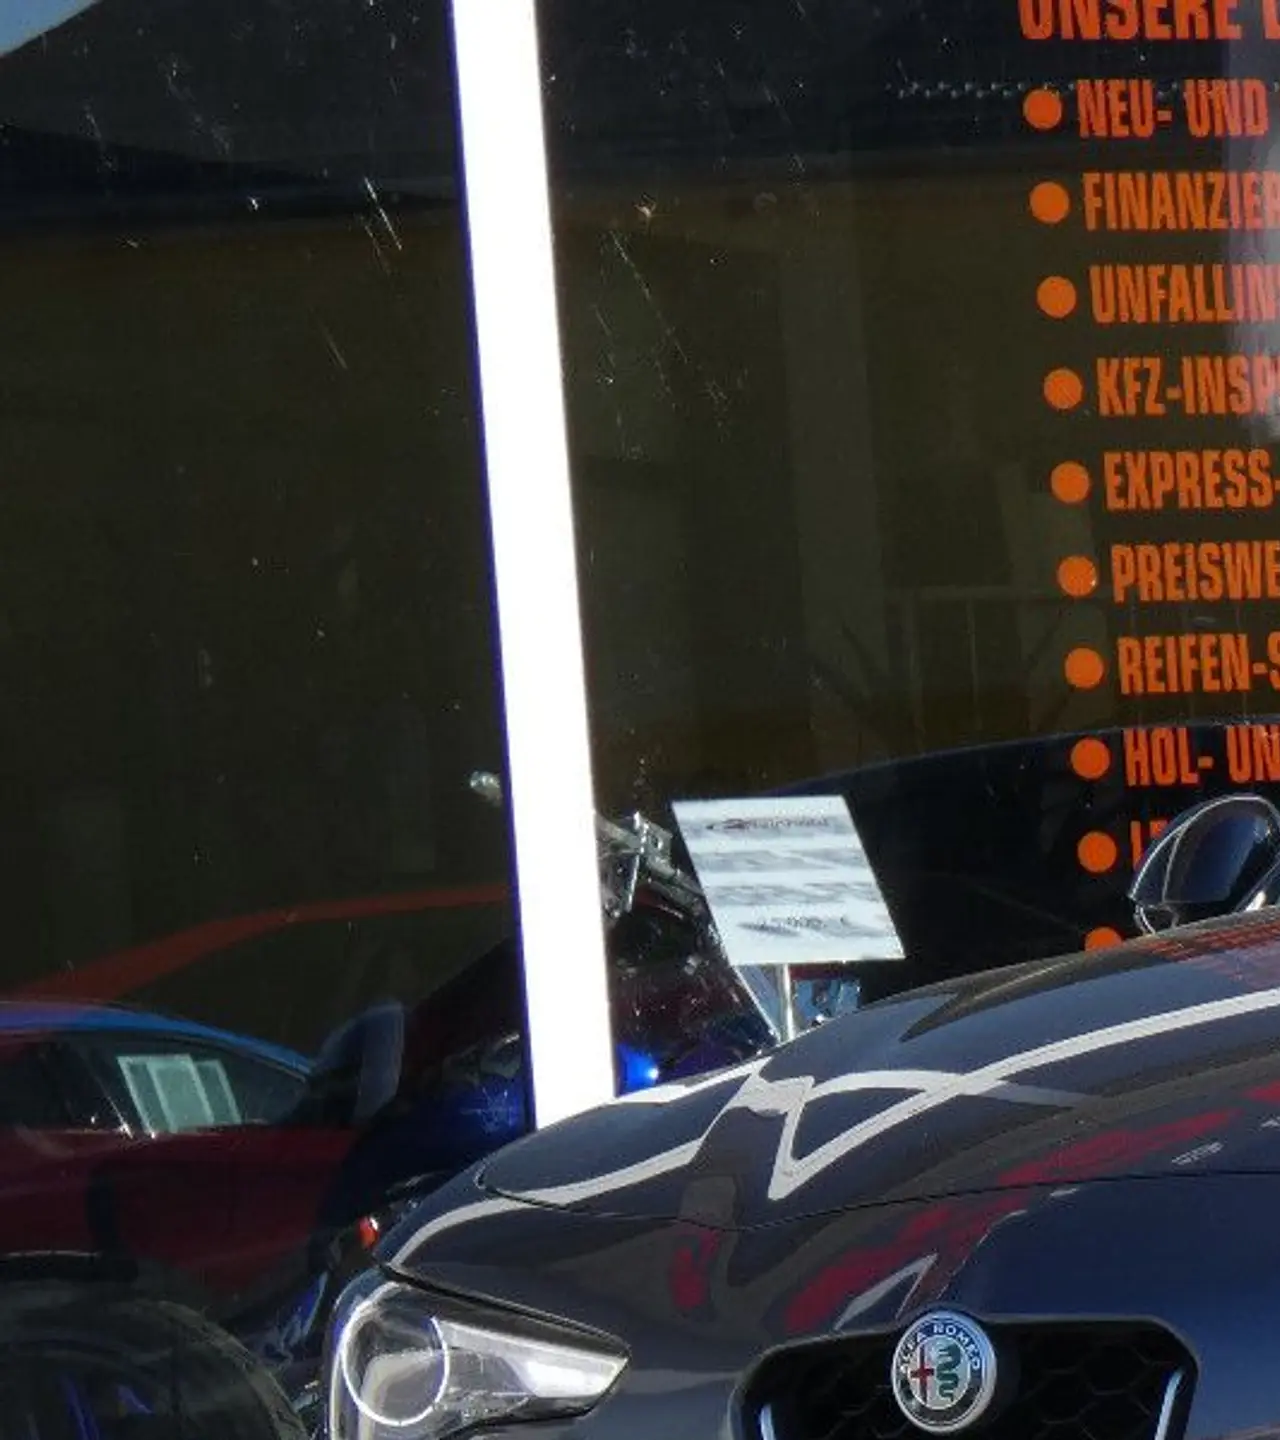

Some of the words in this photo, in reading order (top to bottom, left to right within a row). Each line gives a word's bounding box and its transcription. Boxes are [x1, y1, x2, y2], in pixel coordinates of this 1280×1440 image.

[1076, 78, 1172, 138] NEU-
[1184, 78, 1269, 138] UND
[1124, 727, 1214, 787] HOL-
